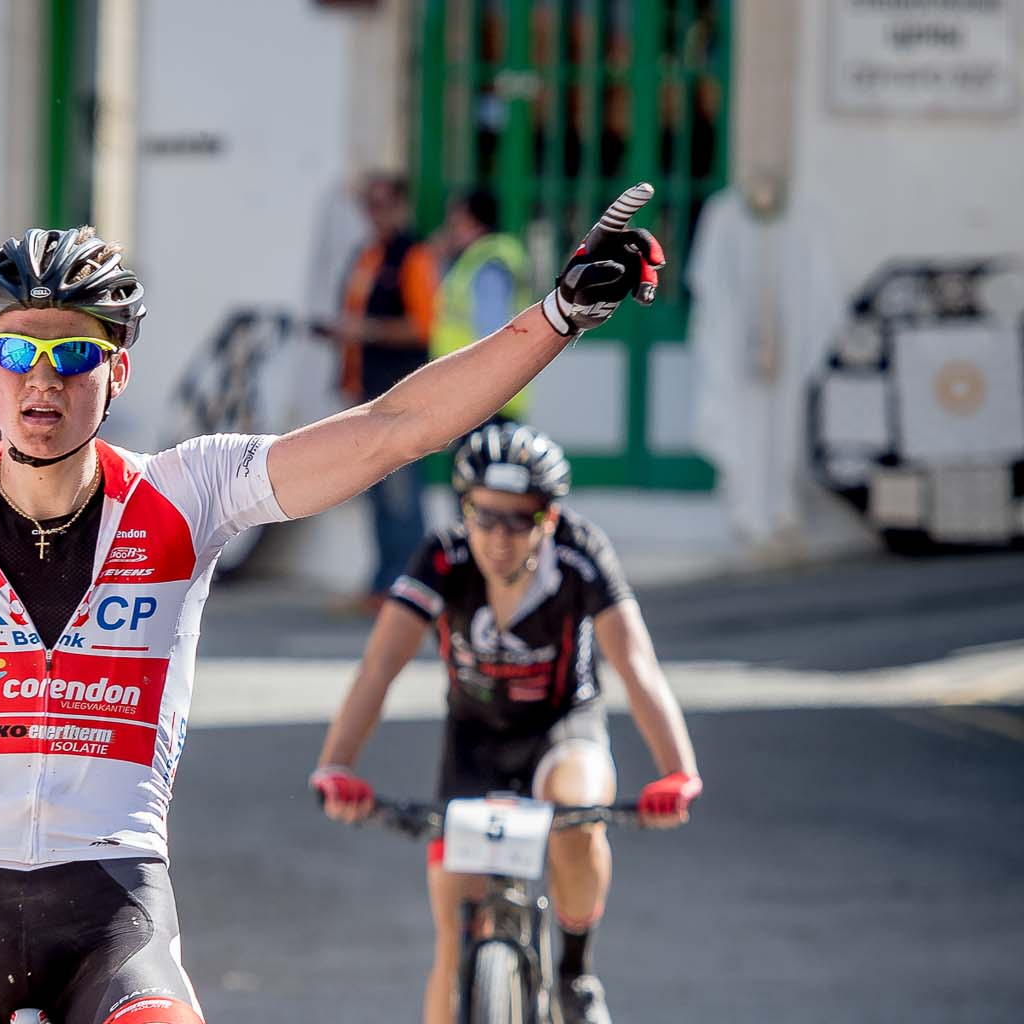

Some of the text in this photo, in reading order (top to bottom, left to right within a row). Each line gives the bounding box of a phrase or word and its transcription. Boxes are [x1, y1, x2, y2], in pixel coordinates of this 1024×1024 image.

[96, 595, 157, 631] CP
[3, 677, 141, 706] corendon
[60, 701, 136, 715] VLIEGVAKANTIES
[50, 741, 109, 755] ISOLATIE
